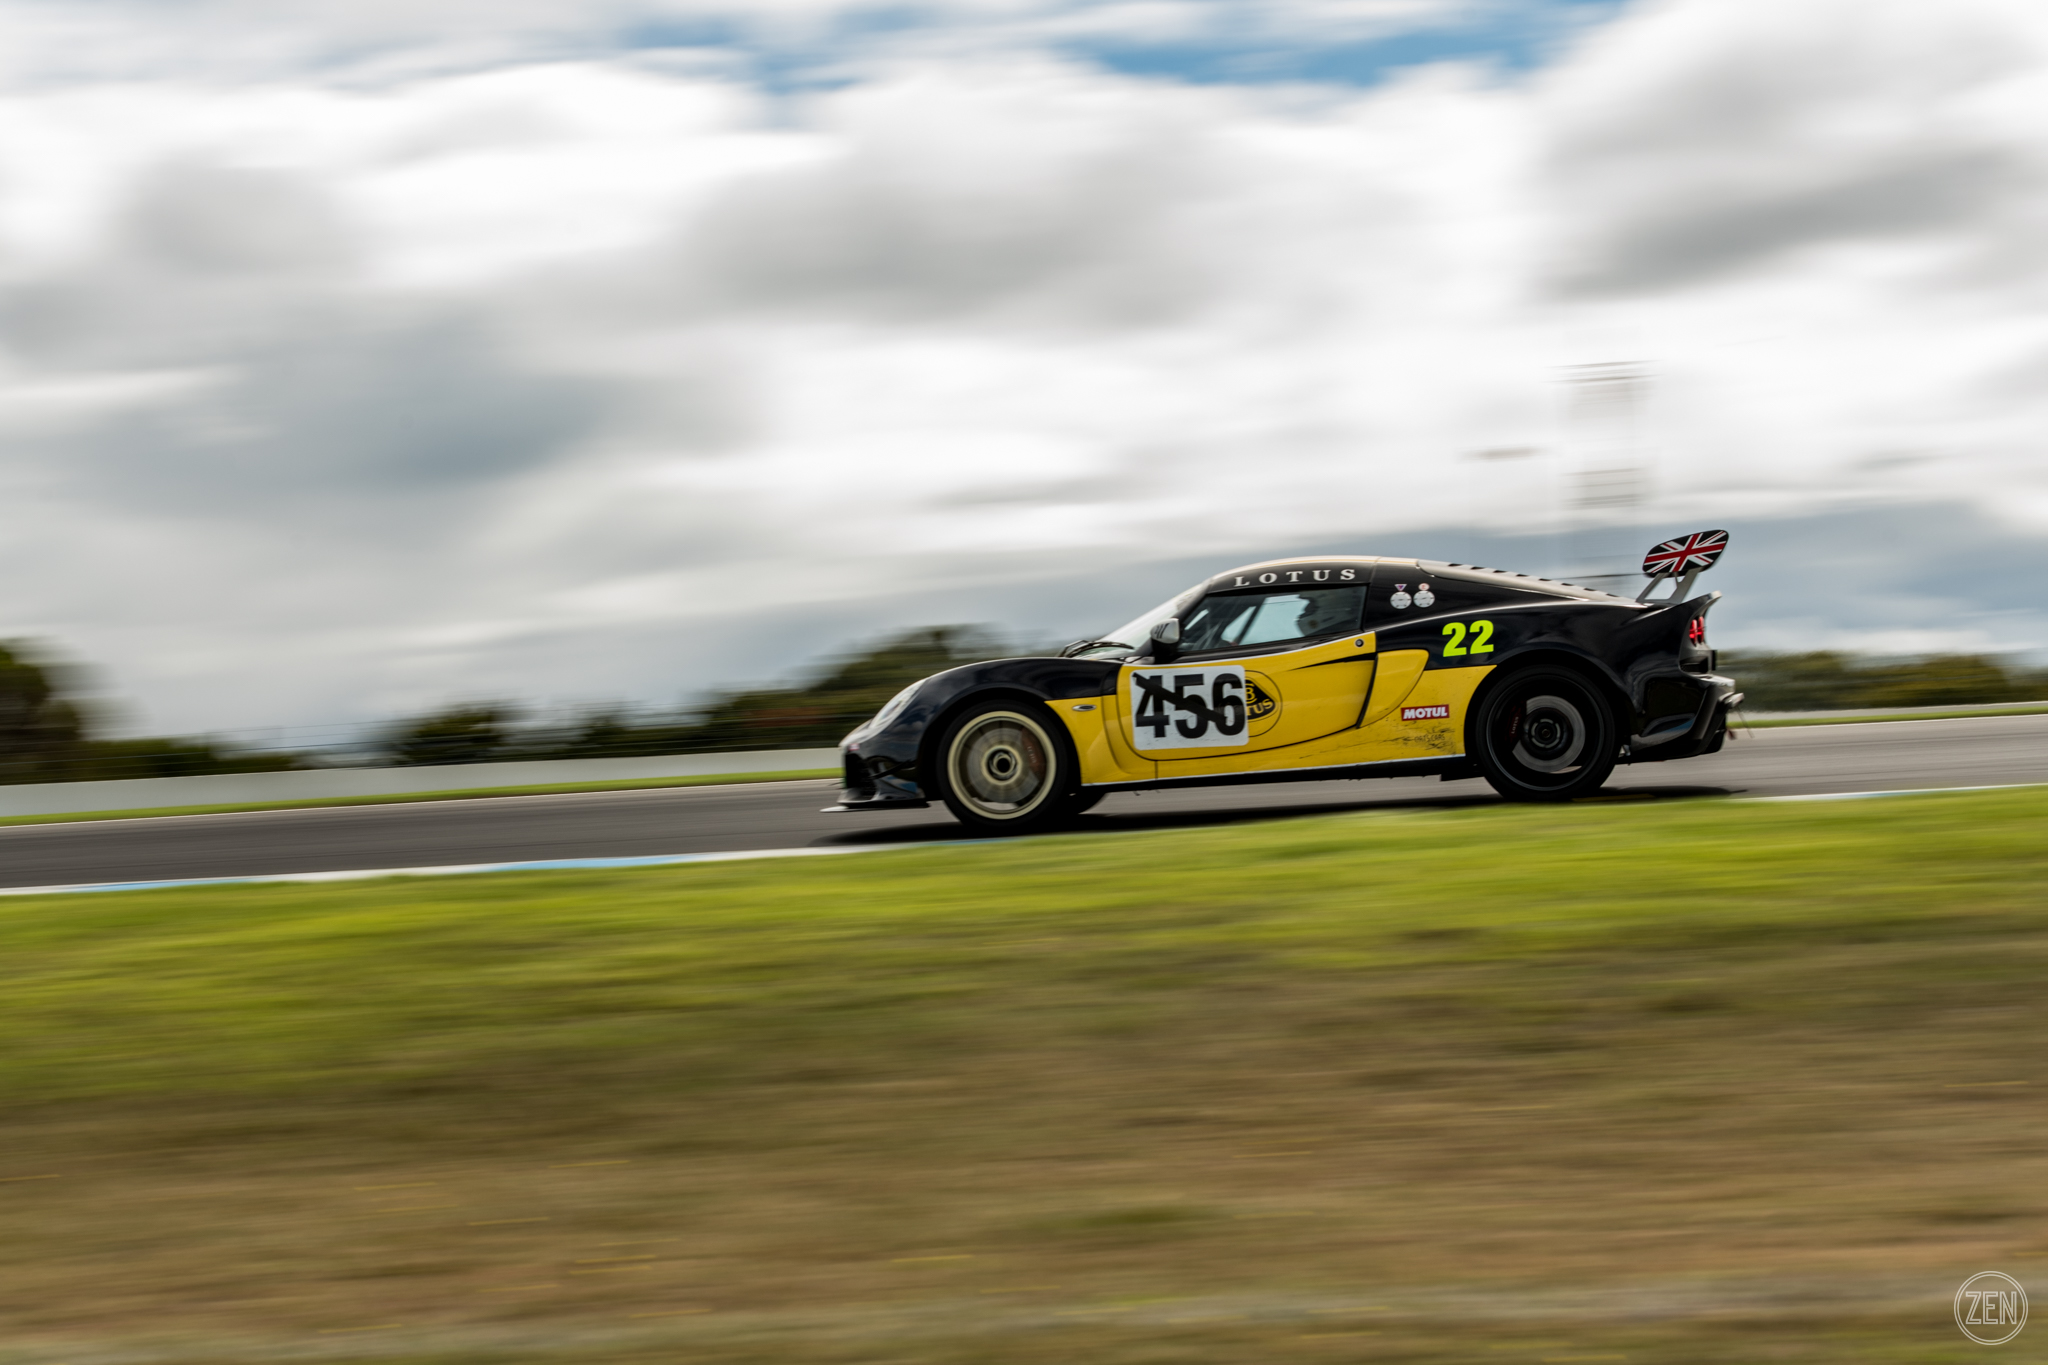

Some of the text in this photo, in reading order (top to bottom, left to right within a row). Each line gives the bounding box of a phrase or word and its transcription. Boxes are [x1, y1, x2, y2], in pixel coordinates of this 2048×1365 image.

[1234, 569, 1356, 587] LOTUS
[1442, 620, 1494, 657] 22
[1135, 673, 1246, 739] 456
[1403, 706, 1448, 719] MOTUL
